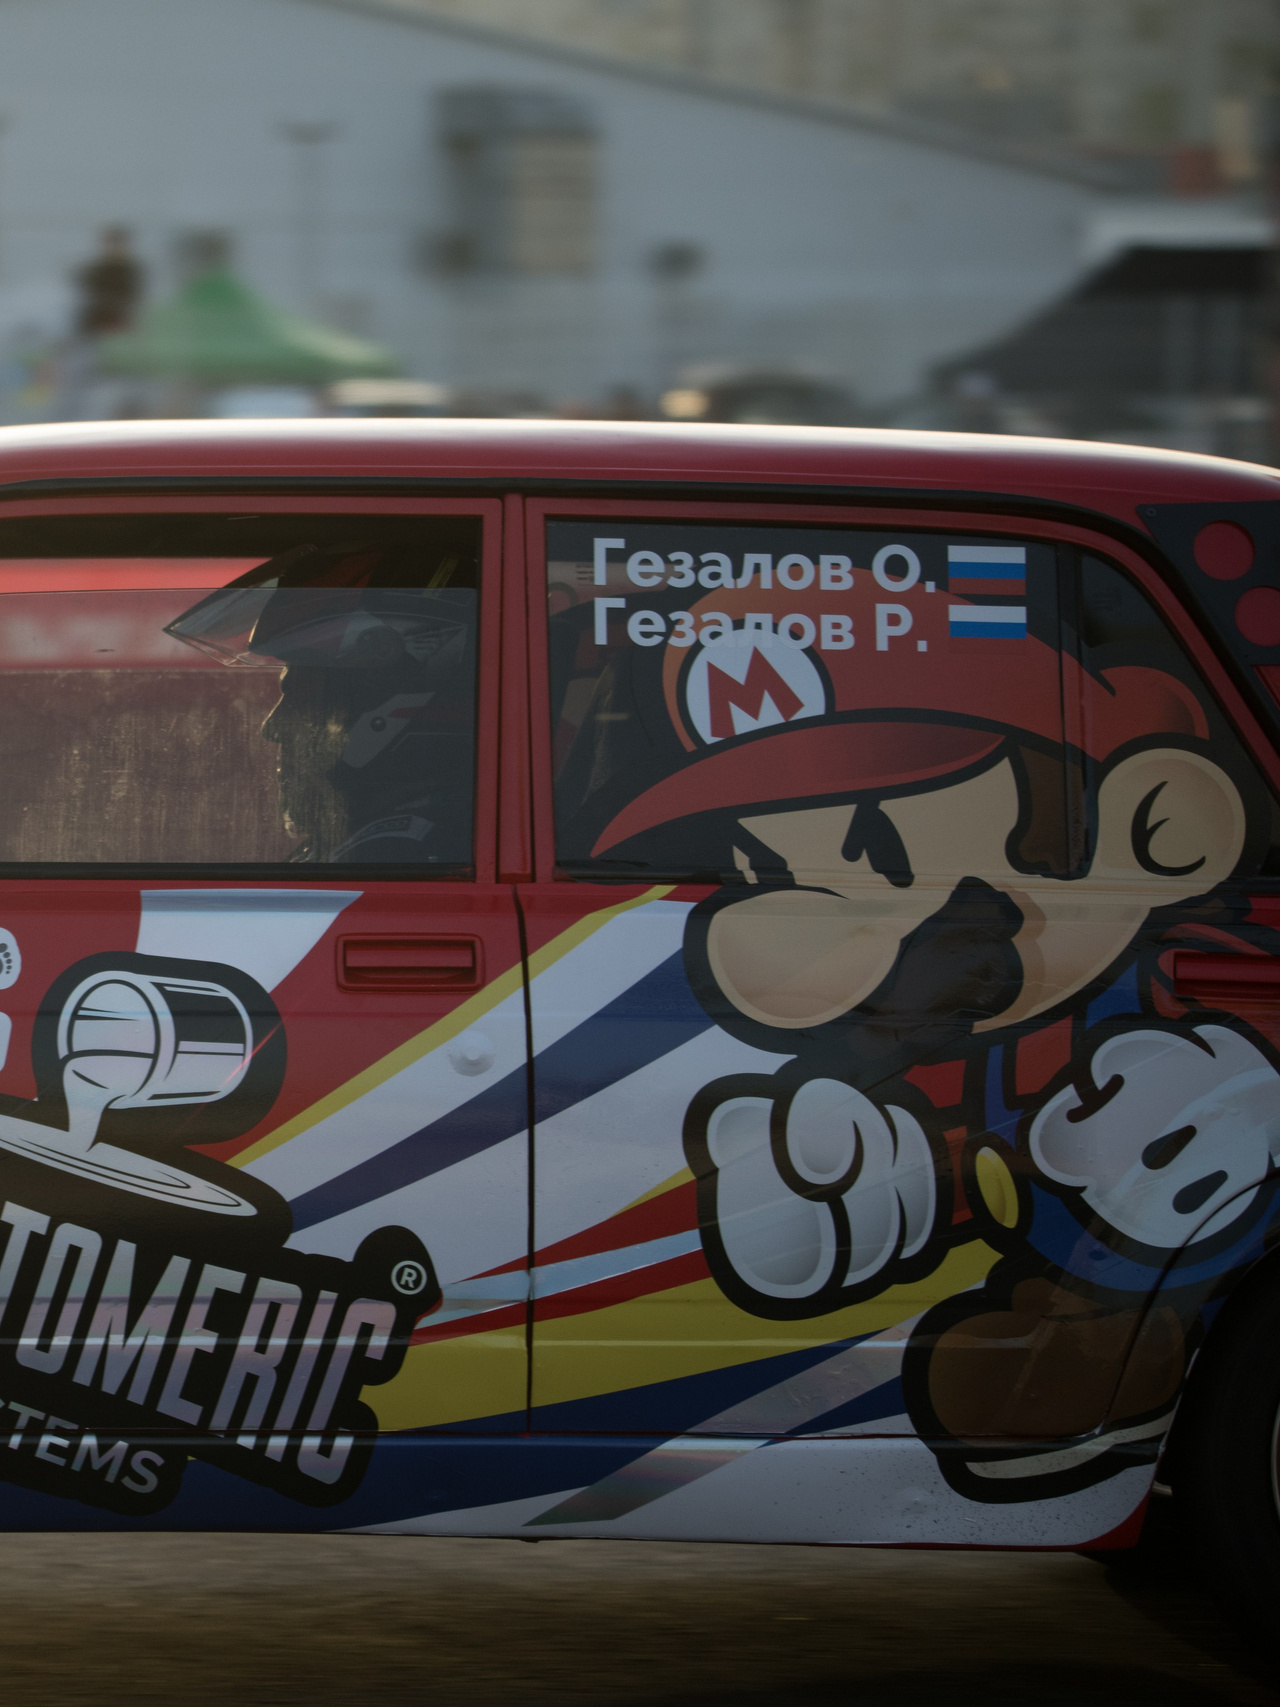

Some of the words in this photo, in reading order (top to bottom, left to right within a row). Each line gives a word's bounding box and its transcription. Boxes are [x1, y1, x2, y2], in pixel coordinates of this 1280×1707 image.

[593, 537, 855, 591] Гезалов
[871, 543, 936, 593] О.
[593, 597, 856, 651] Гезалов
[875, 602, 928, 652] Р.
